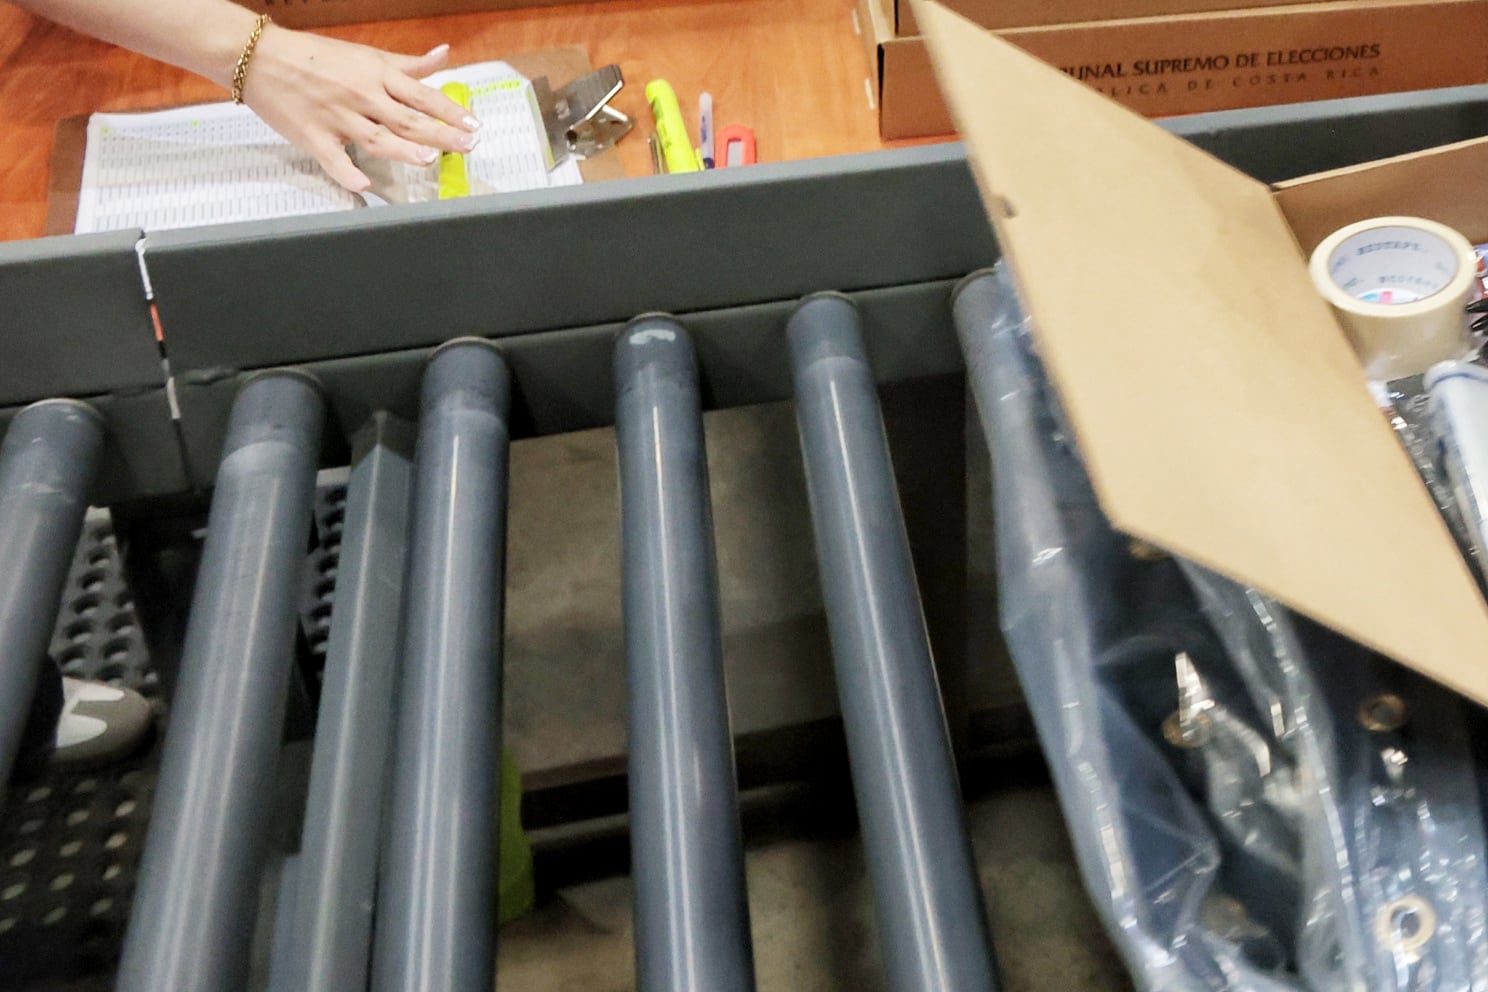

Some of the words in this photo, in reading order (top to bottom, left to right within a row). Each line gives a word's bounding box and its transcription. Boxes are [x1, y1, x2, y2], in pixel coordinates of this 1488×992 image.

[1133, 54, 1230, 76] SUPREMO
[1235, 52, 1260, 69] DE
[1266, 43, 1382, 67] ELECCIONES
